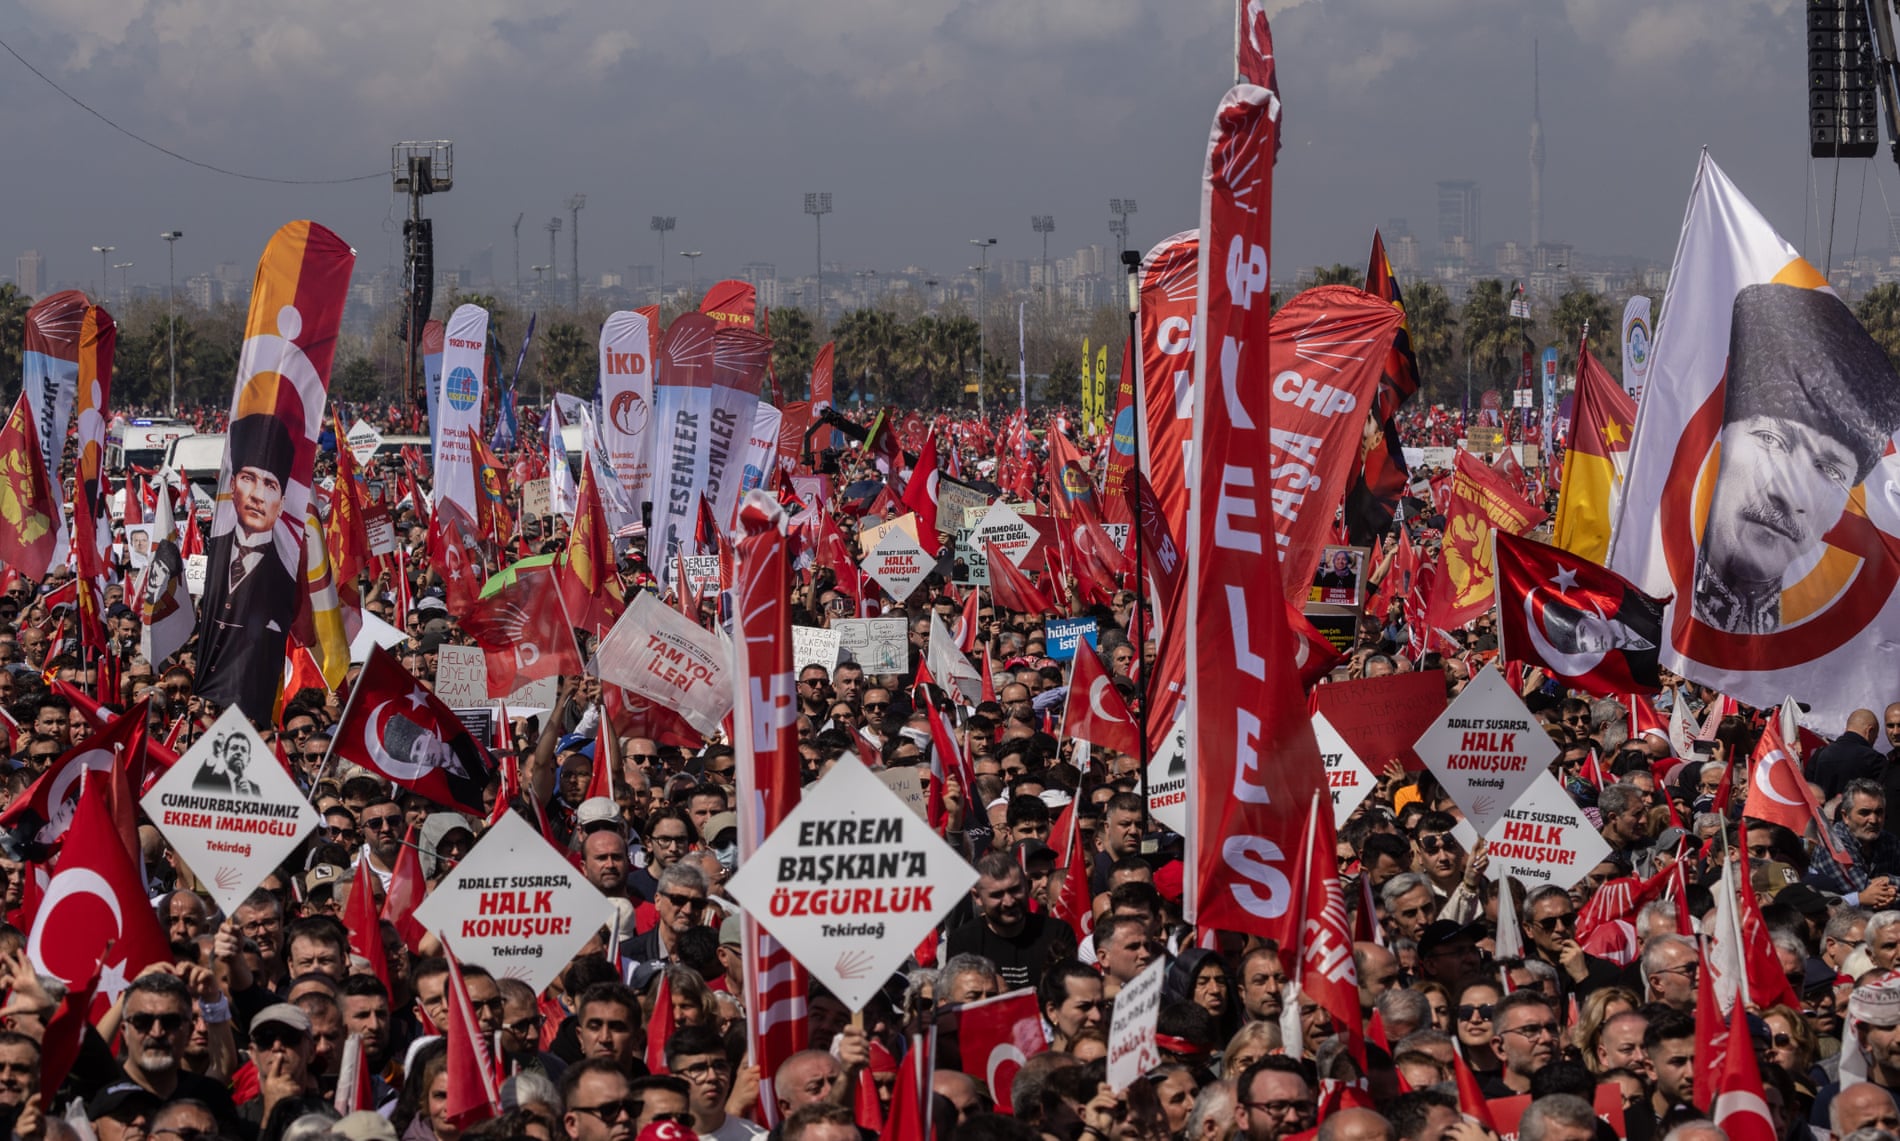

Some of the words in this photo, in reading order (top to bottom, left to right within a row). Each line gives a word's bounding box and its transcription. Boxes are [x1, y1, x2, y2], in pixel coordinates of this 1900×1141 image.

[606, 346, 646, 374] İKD
[1272, 370, 1356, 418] CHP
[669, 409, 698, 517] ESENLER
[878, 566, 920, 576] KONUŞUR!
[884, 556, 913, 566] HALK
[1047, 621, 1097, 639] hükümet
[646, 634, 685, 665] TAM
[685, 657, 714, 687] YOL
[648, 654, 696, 693] İLERİ
[1447, 718, 1484, 730] ADALET
[1485, 719, 1530, 732] SUSARSA,
[1461, 731, 1516, 753] HALK
[1447, 755, 1528, 773] KONUŞUR!
[1468, 778, 1505, 790] Tekirdağ
[161, 793, 300, 819] CUMHURBAŞKANIMIZ
[163, 811, 212, 830] EKREM
[1531, 812, 1579, 829] SUSARSA,
[798, 818, 903, 847] EKREM
[1503, 821, 1564, 846] HALK
[206, 840, 252, 857] Tekirdağ
[1488, 841, 1576, 865] KONUŞUR!
[777, 851, 927, 885] BAŞKAN'A
[1510, 866, 1552, 880] Tekirdağ
[458, 876, 509, 890] ADALET
[510, 875, 572, 889] SUSARSA,
[478, 890, 554, 915] HALK
[769, 885, 934, 918] ÖZGÜRLÜK
[461, 917, 572, 939] KONUŞUR!
[821, 922, 885, 940] Tekirdağ
[491, 944, 543, 958] Tekirdağ
